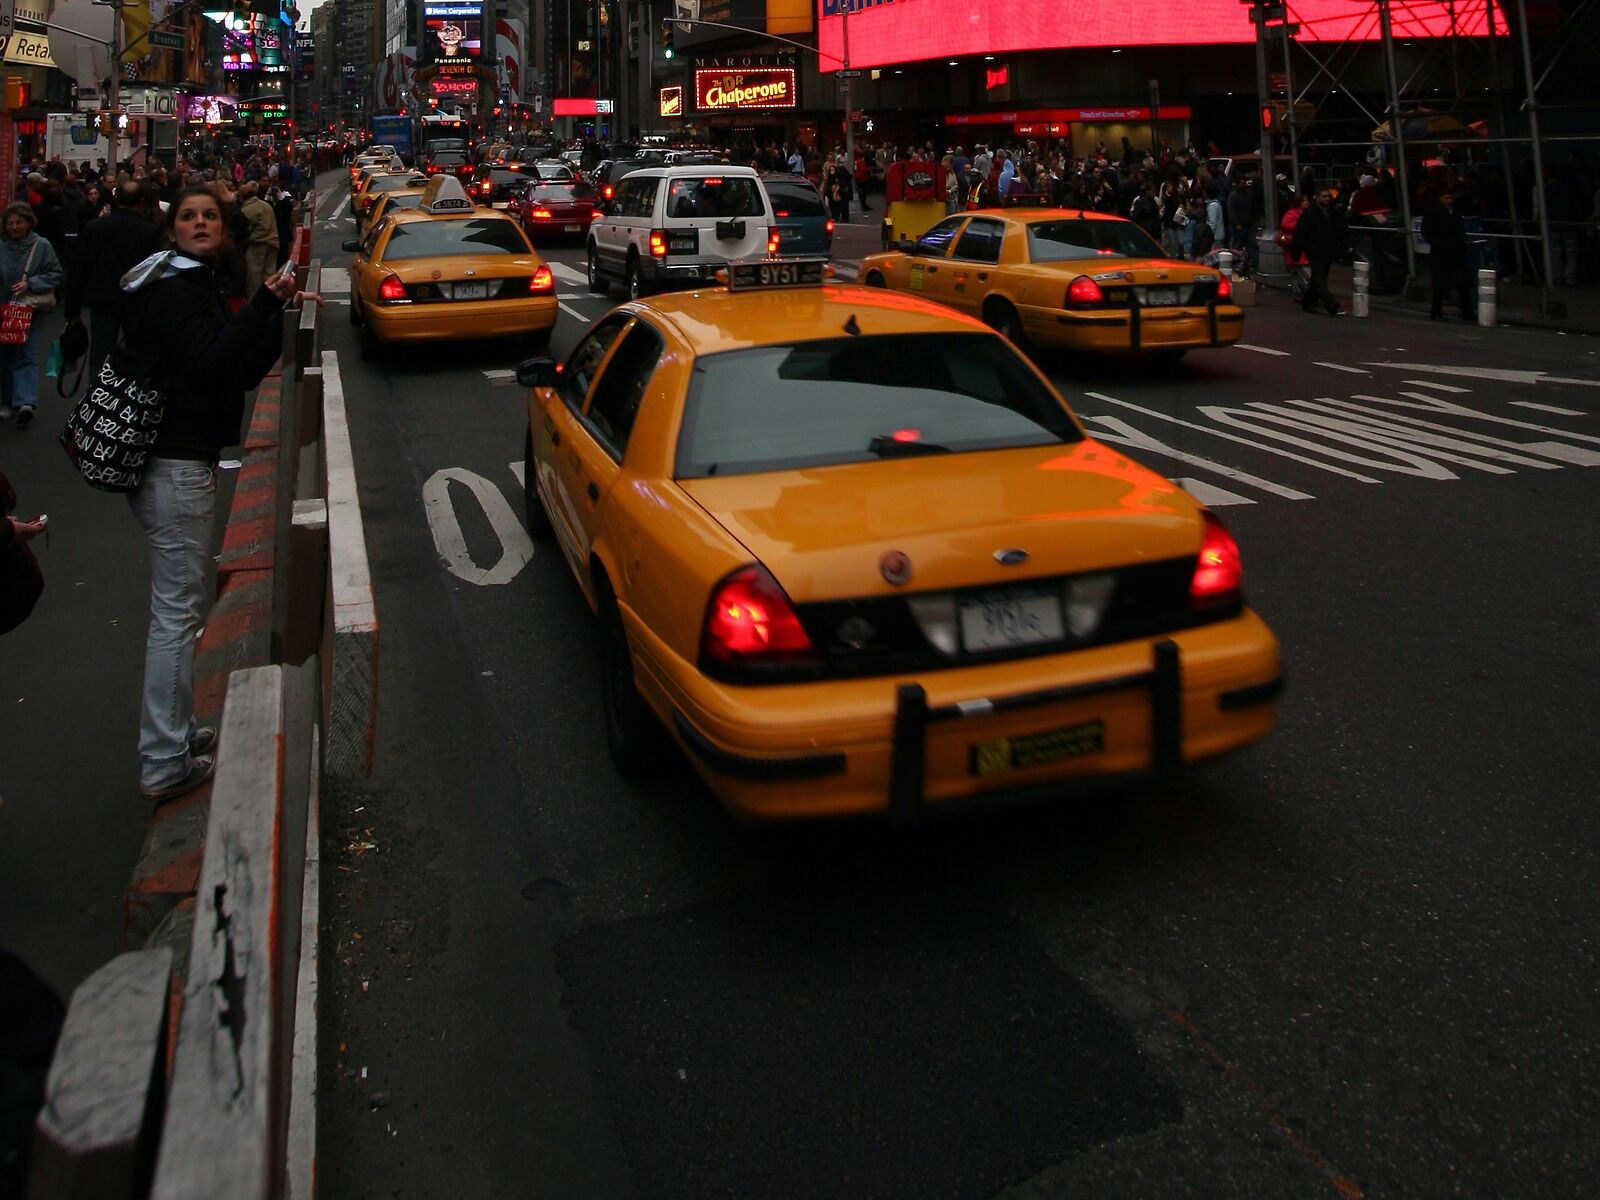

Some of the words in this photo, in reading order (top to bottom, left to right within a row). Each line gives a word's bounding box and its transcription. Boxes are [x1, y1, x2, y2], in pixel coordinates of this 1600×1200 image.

[296, 39, 315, 48] NFL
[695, 57, 796, 67] MARQUIS
[432, 80, 478, 93] YAHOO!
[706, 81, 787, 106] Chaperone
[760, 264, 798, 284] 9Y51
